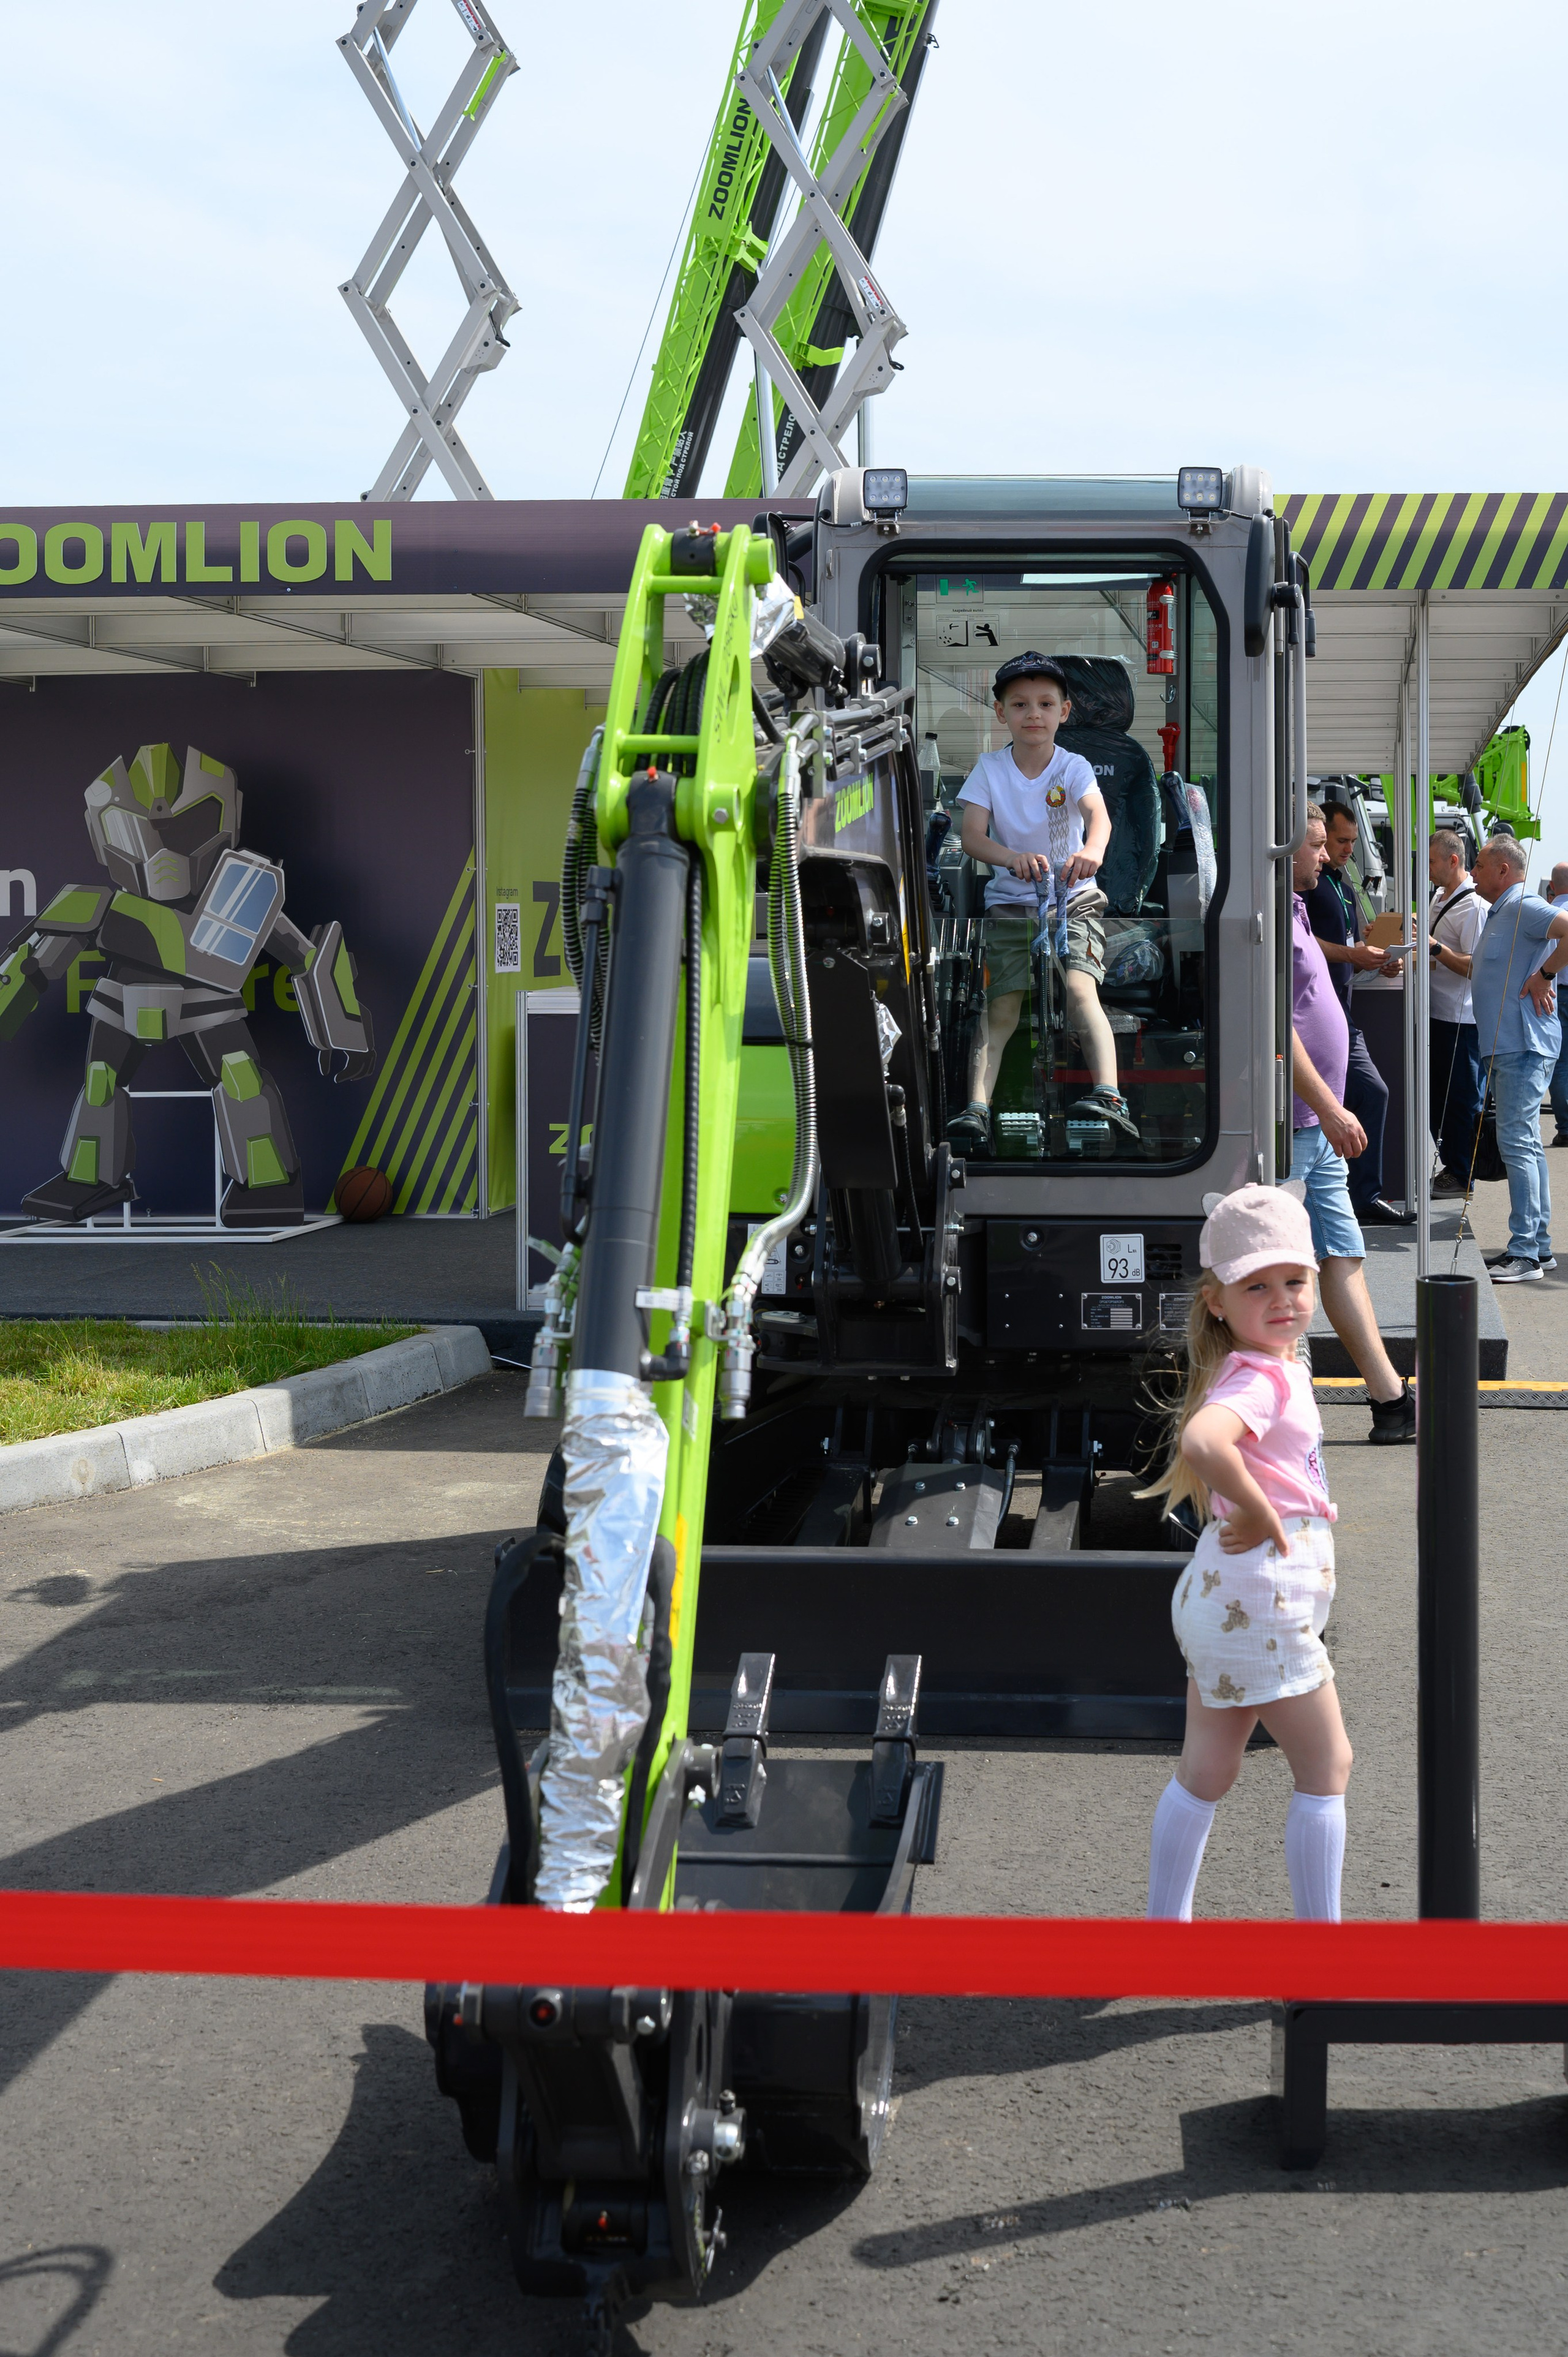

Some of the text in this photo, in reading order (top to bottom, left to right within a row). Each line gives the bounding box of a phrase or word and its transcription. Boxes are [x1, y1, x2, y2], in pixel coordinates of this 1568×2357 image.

[708, 97, 752, 221] ZOOMLION
[777, 413, 796, 459] СТРЕЛО
[0, 520, 393, 585] OOMLION
[834, 772, 874, 833] ZOOMLION
[496, 887, 519, 899] Instagram
[1108, 1258, 1129, 1279] 93
